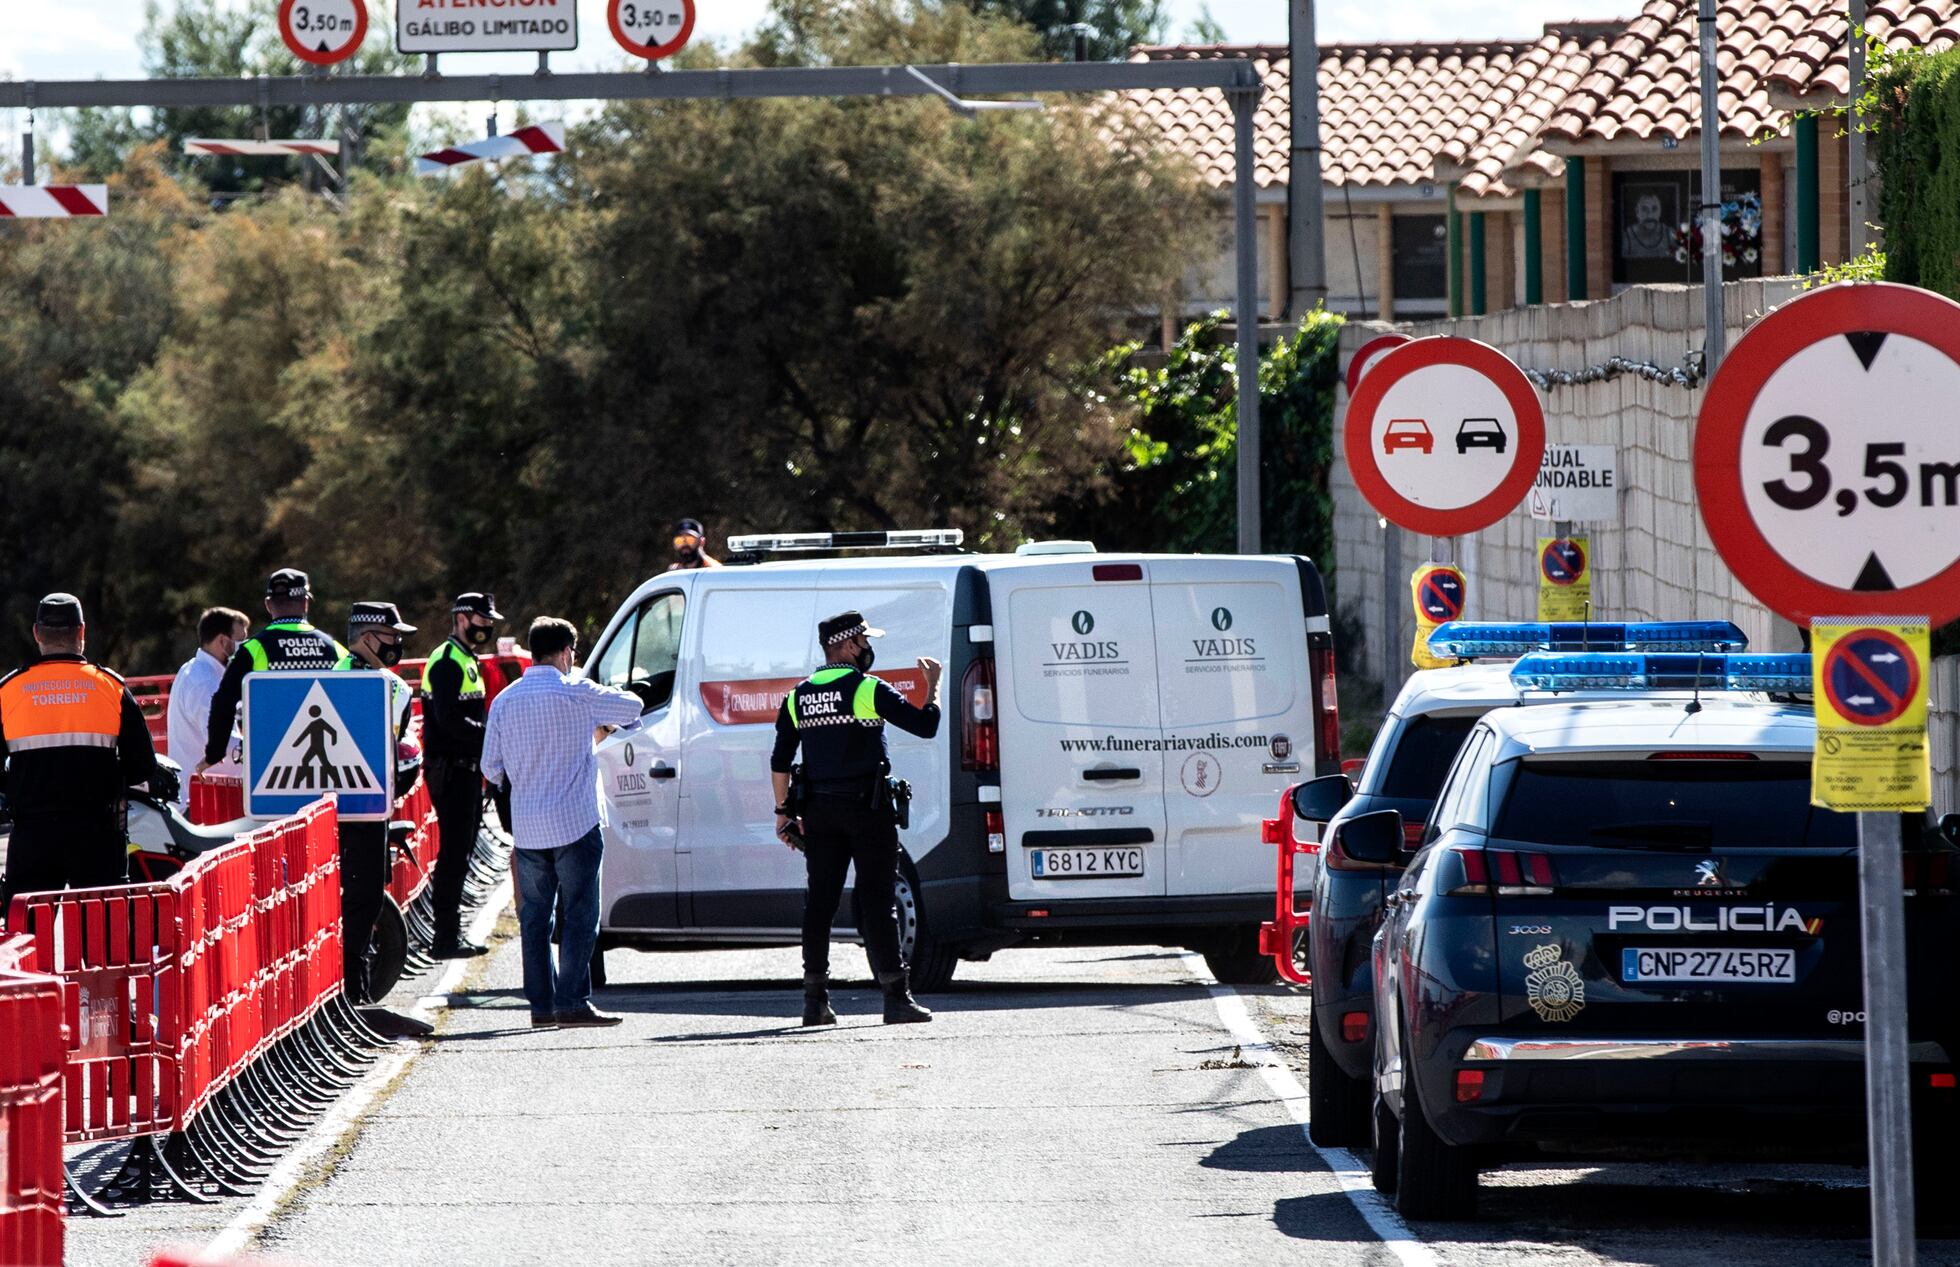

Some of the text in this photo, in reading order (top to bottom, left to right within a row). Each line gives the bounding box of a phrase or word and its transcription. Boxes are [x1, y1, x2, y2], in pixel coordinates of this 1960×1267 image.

[296, 7, 352, 31] 3,50 m
[623, 3, 681, 29] 3,50 m
[406, 18, 568, 36] GÁLIBO LIMITADO
[1533, 469, 1613, 488] UNDABLE
[278, 637, 326, 648] POLICIA
[1051, 641, 1119, 660] VADIS
[1193, 638, 1256, 656] VADIS
[285, 647, 324, 657] LOCAL
[32, 692, 88, 705] TORRENT
[799, 691, 842, 706] POLICIA
[803, 702, 838, 716] LOCAL
[1060, 733, 1268, 752] www.funerariavadis.com
[616, 773, 646, 791] VADIS
[1048, 851, 1139, 872] 6812 KYC
[1609, 901, 1808, 932] POLICÍA
[1508, 925, 1552, 935] 3008
[1827, 1009, 1867, 1025] @po
